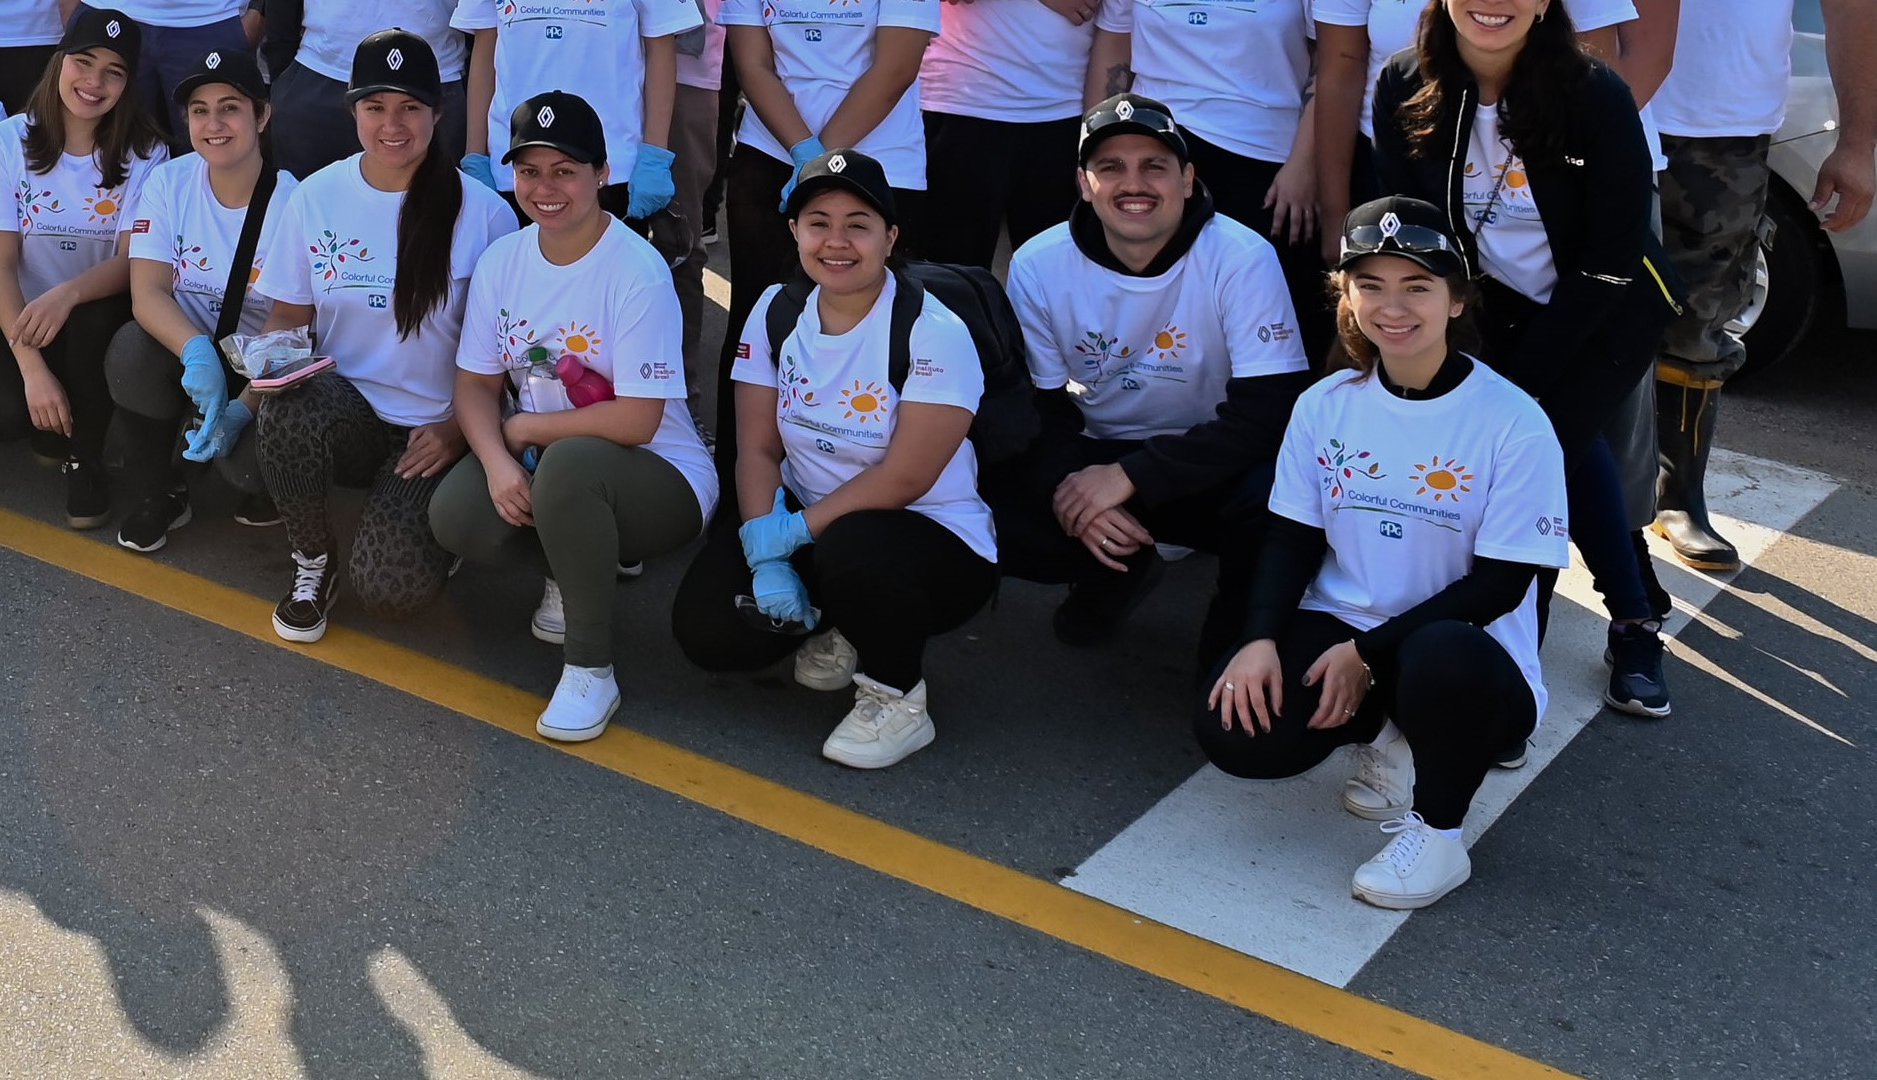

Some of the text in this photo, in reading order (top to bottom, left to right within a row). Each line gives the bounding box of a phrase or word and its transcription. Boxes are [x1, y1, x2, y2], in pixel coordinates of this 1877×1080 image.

[520, 6, 605, 16] Colorful Communities
[780, 10, 862, 19] Colorful Communities
[1189, 12, 1207, 25] PPG
[546, 26, 563, 39] PPG
[805, 29, 822, 42] PPG
[37, 223, 66, 233] Colorful
[341, 272, 375, 283] Colorful
[369, 295, 386, 308] PPG
[822, 422, 883, 439] Communities
[816, 438, 835, 454] PPG
[1348, 490, 1461, 520] Colorful Communities
[1380, 521, 1402, 539] PPG
